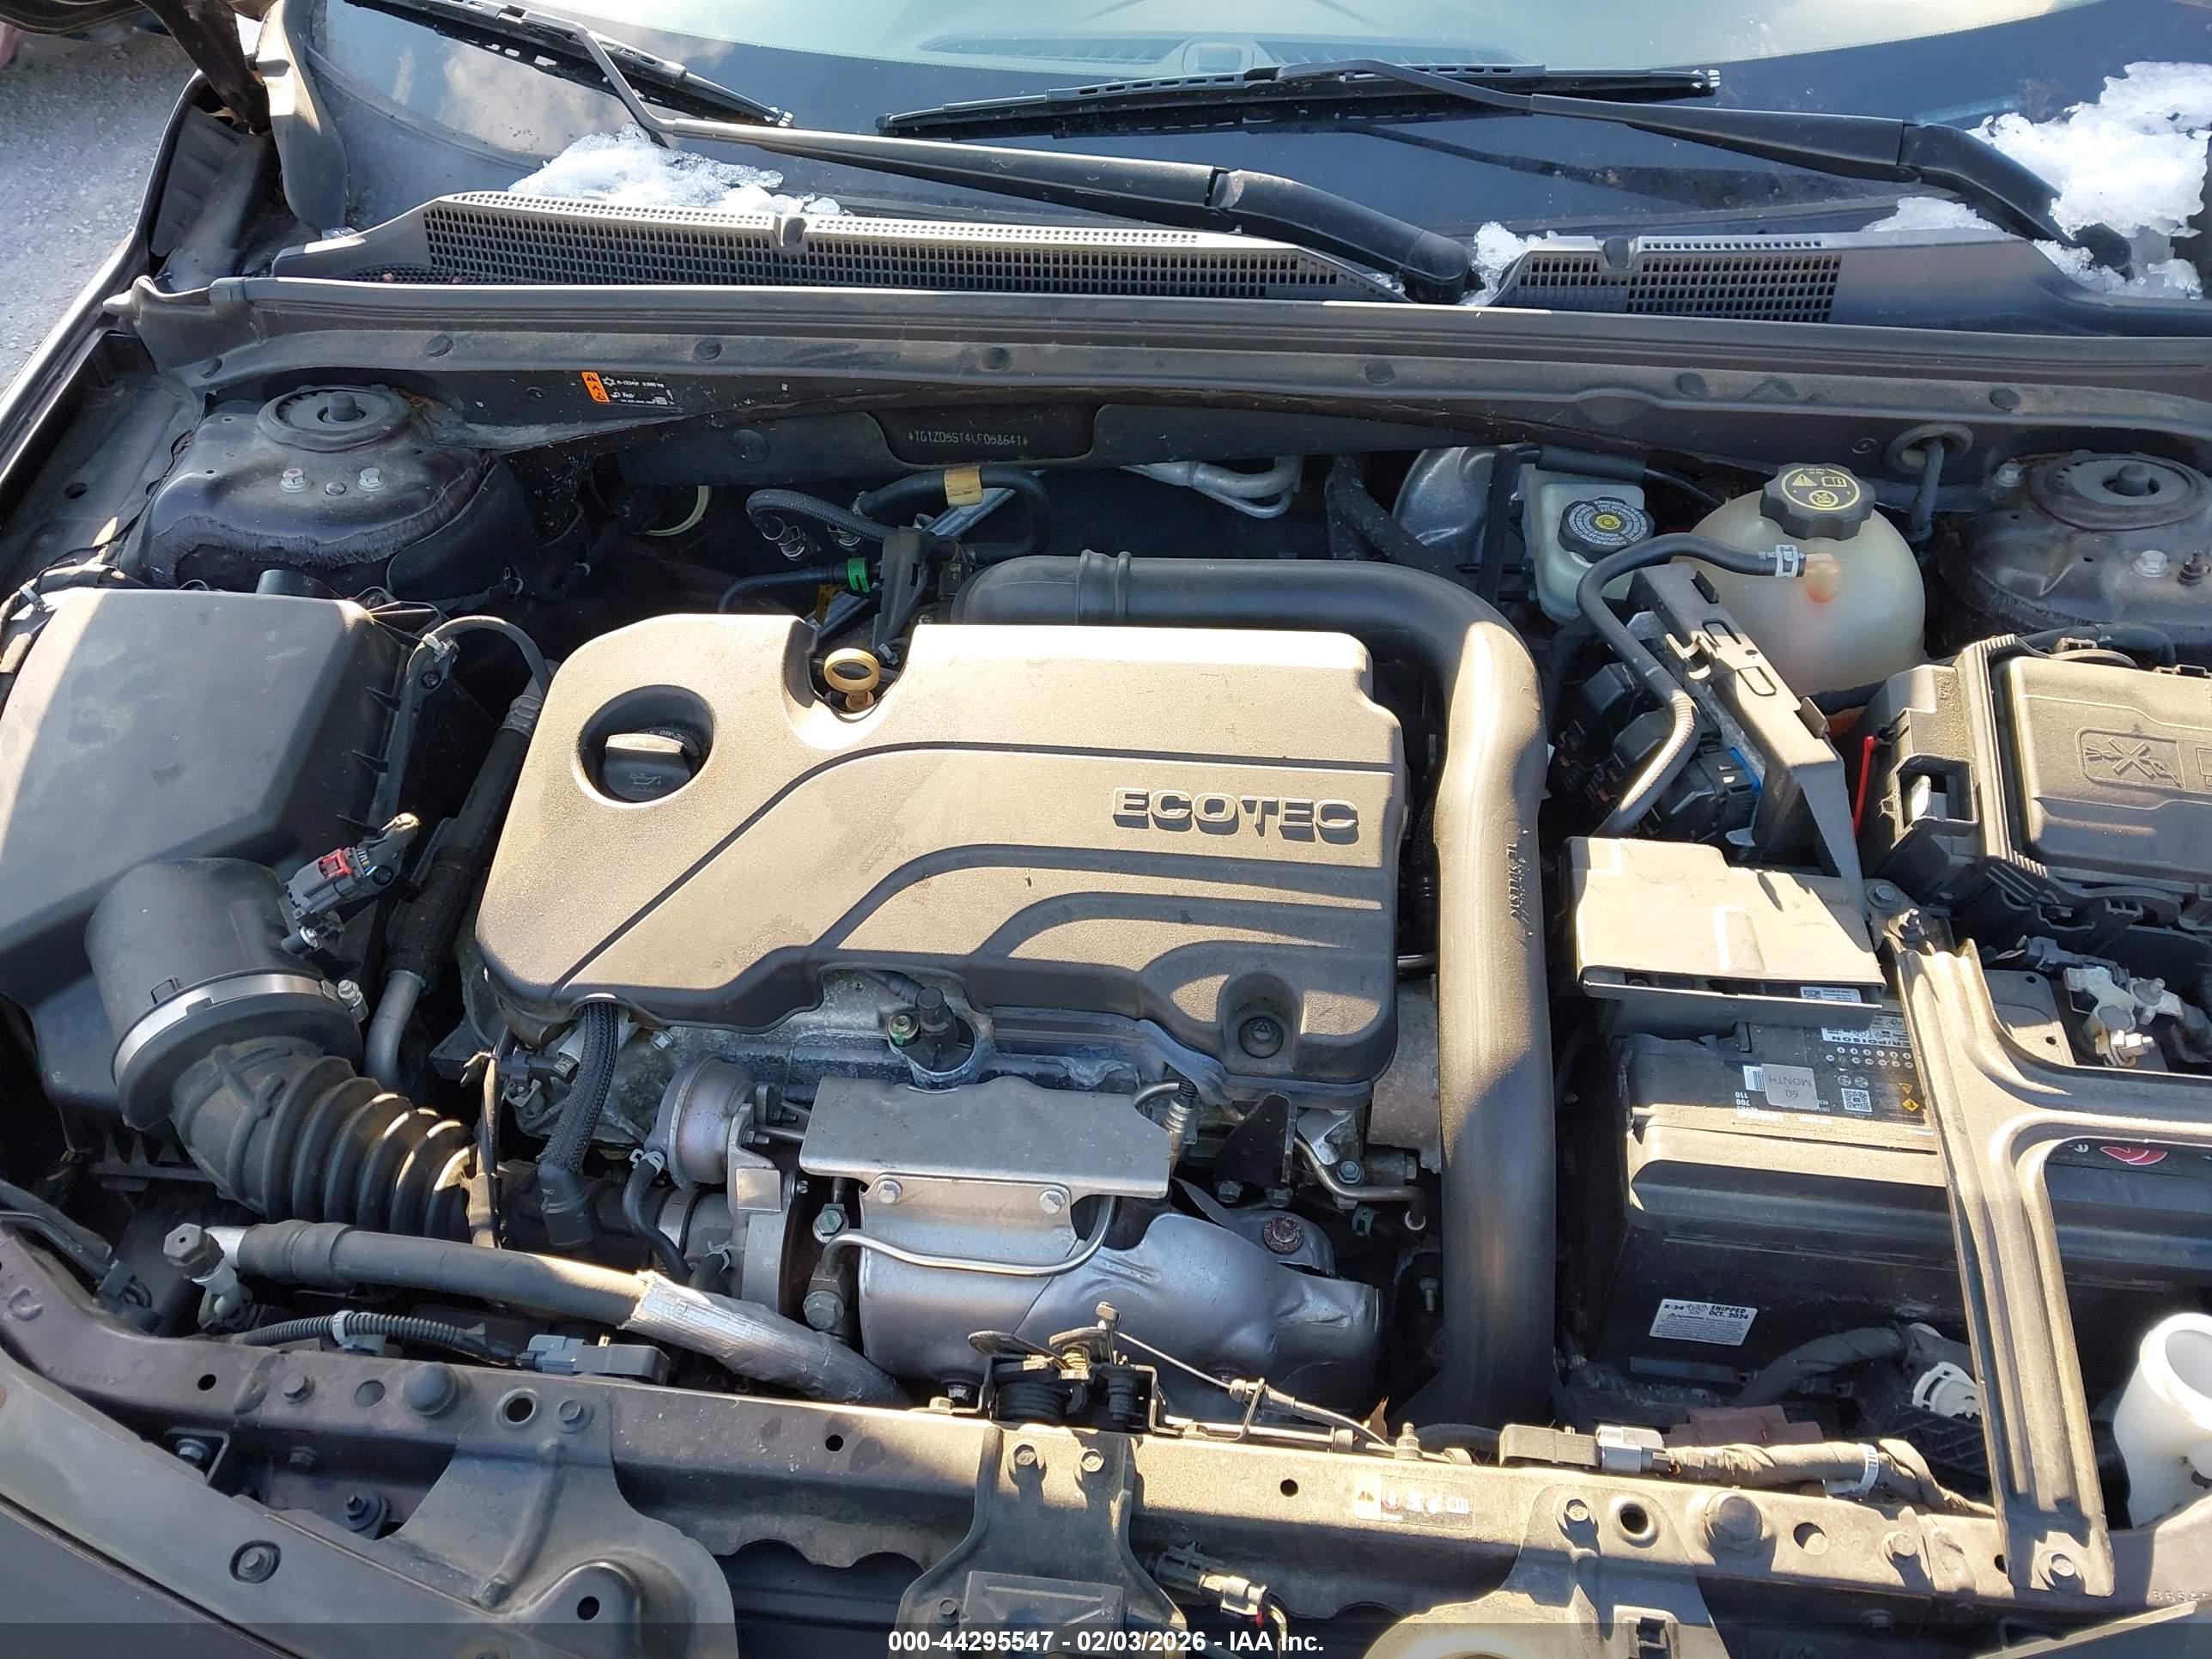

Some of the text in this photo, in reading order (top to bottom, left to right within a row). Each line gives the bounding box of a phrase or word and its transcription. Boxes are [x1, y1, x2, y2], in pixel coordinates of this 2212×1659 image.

[659, 730, 685, 740] 0W-20
[1113, 787, 1359, 843] ECOTEC
[1768, 1075, 1812, 1087] MONTH
[1785, 1089, 1799, 1098] 60
[1711, 1304, 1747, 1314] SHIPPED
[1729, 1311, 1749, 1320] 2024
